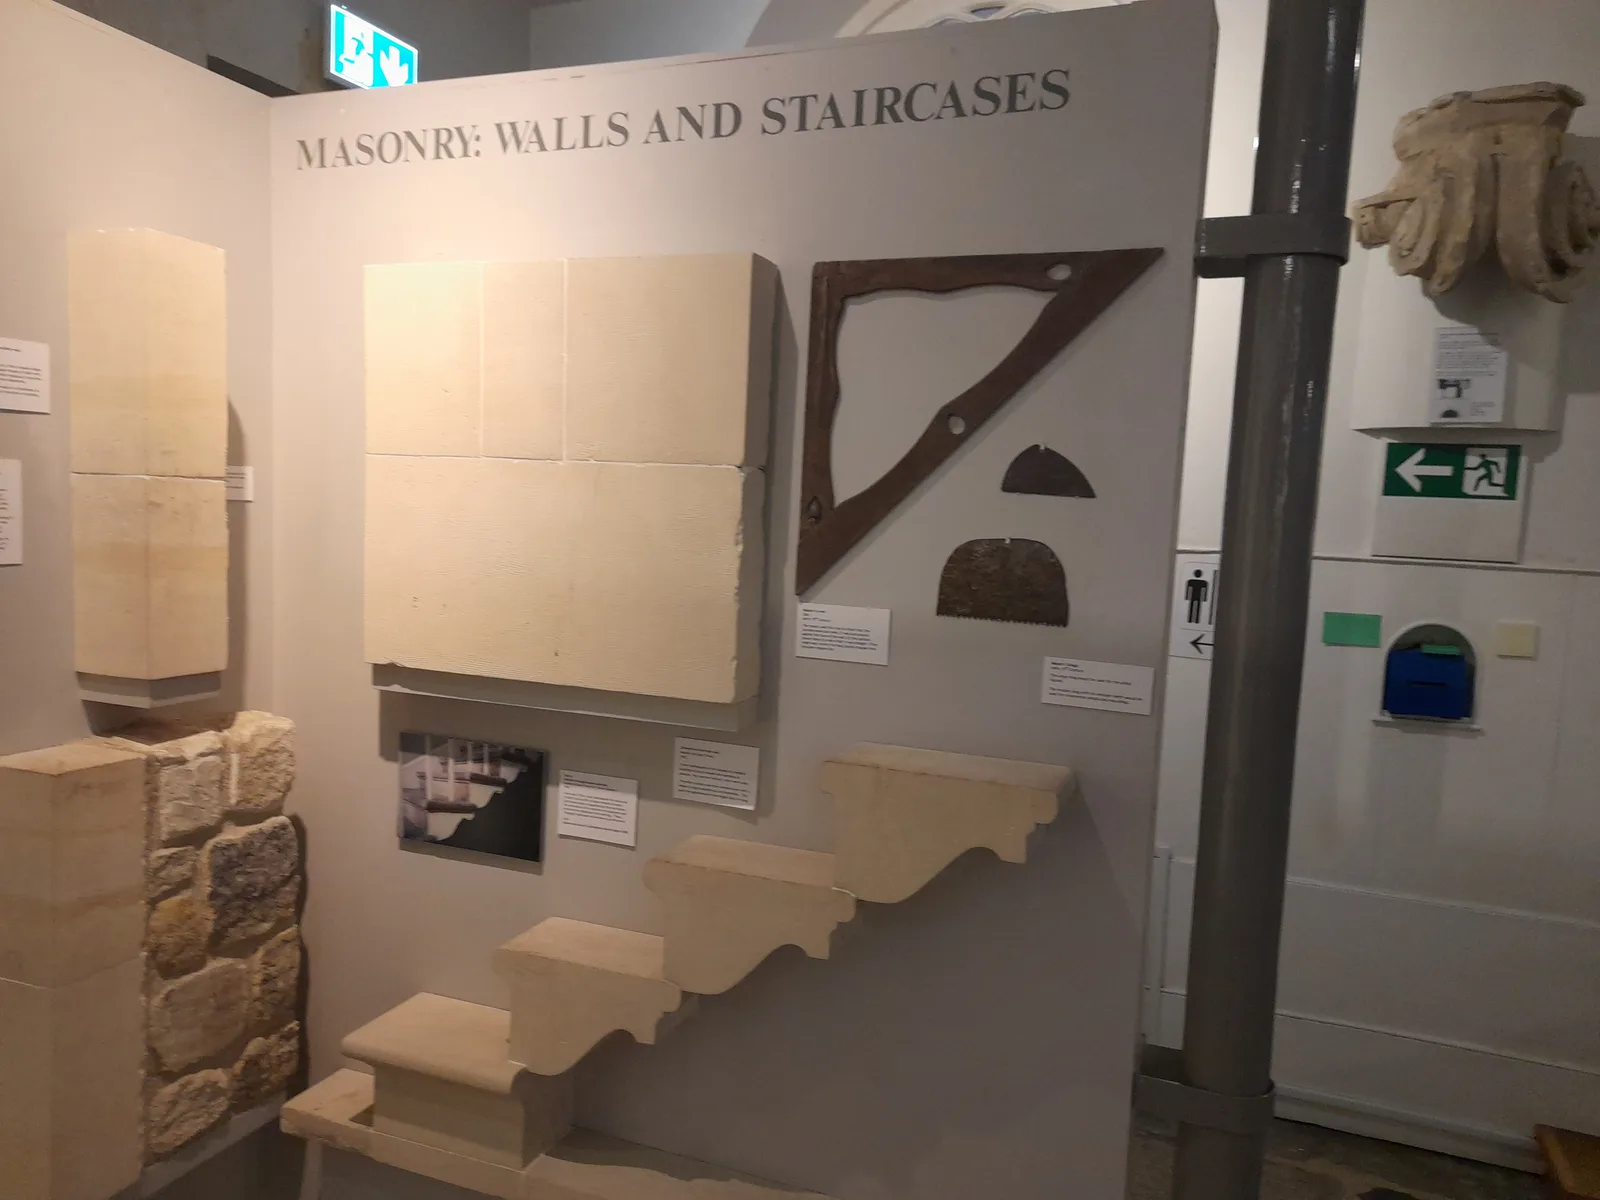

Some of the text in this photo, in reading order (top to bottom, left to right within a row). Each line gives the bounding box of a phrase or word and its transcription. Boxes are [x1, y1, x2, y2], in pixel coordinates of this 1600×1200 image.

[296, 69, 1071, 170] MASONRY: WALLS AND STAIRCASES
